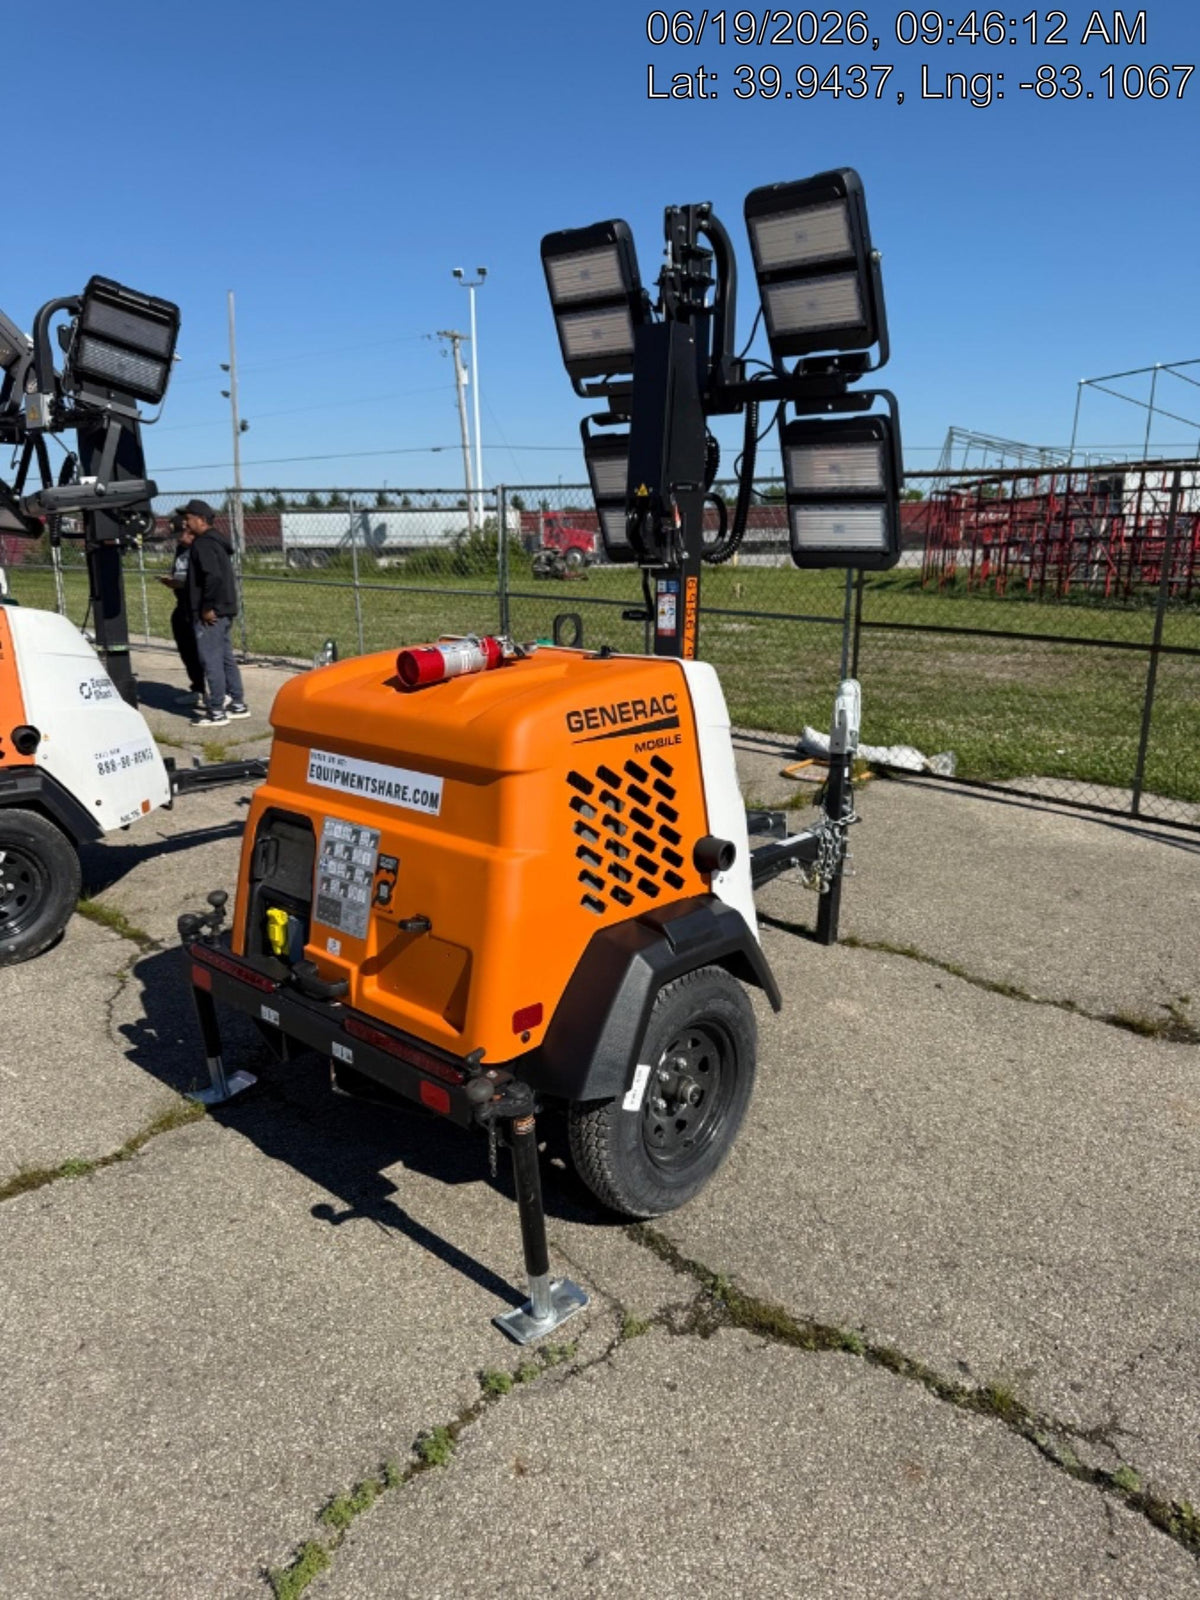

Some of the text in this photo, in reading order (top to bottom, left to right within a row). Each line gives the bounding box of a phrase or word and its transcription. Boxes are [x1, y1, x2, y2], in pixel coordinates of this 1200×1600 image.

[566, 693, 678, 733] GENERAC
[634, 733, 682, 753] MOBILE
[308, 764, 439, 809] EQUIPMENTSHARE.COM
